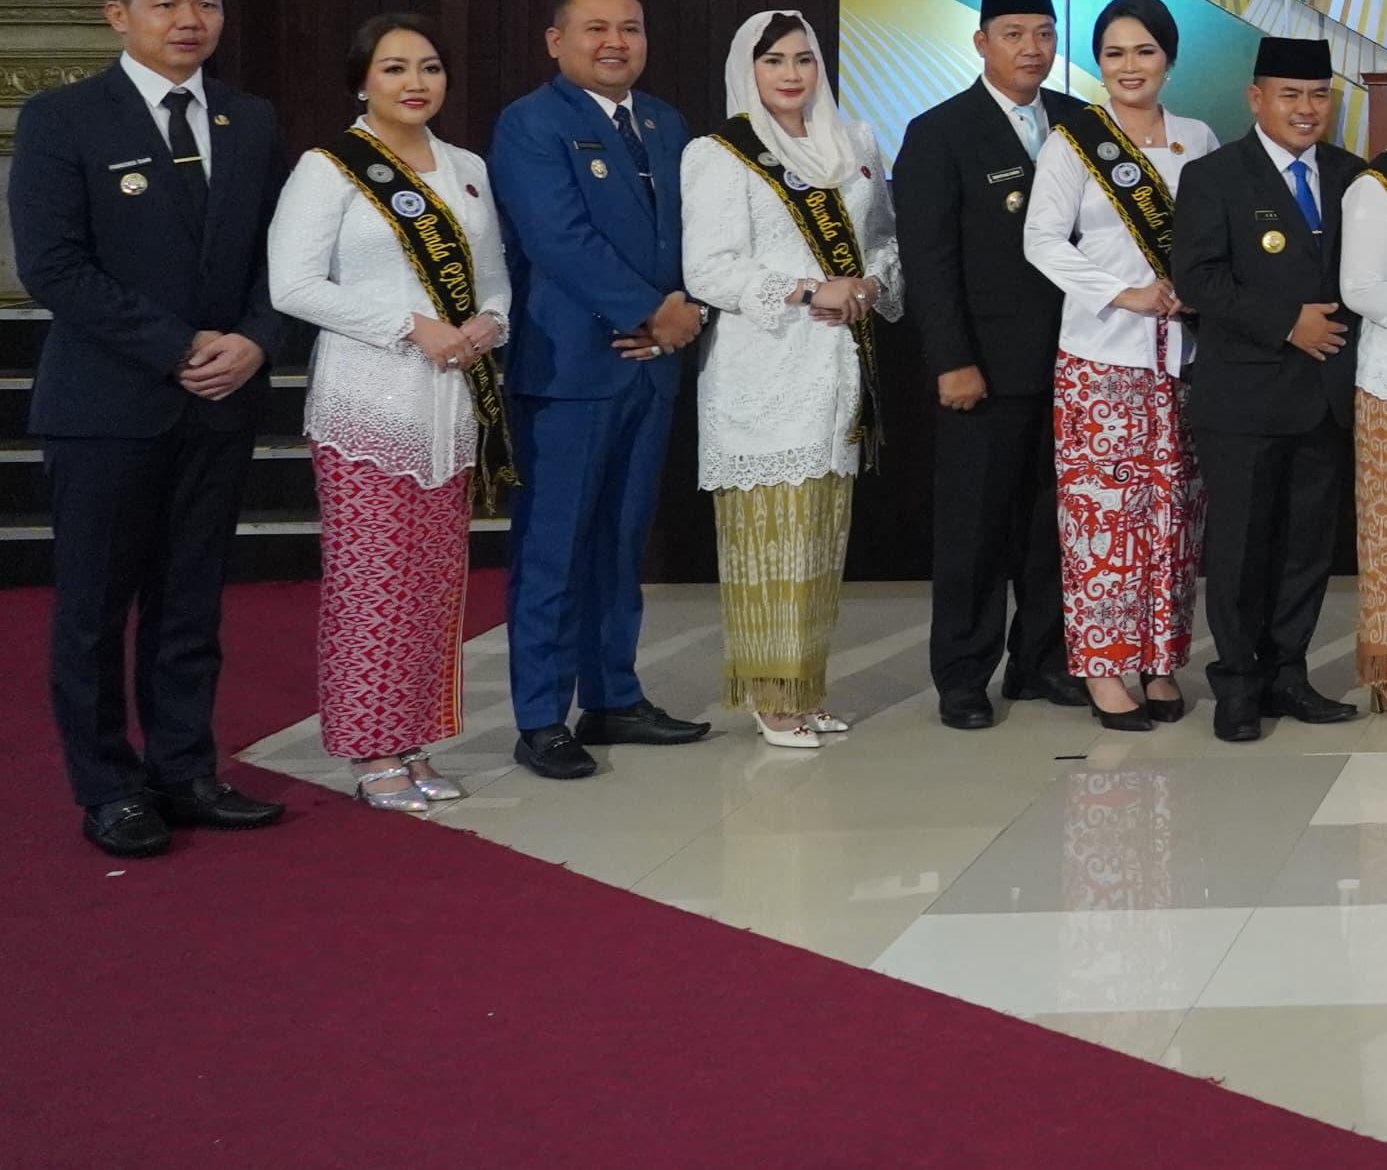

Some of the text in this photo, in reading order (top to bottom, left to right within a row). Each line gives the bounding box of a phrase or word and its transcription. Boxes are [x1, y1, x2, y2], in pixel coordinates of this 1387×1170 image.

[804, 191, 861, 279] Bunda PAU
[1130, 186, 1173, 230] Bunda
[413, 214, 472, 312] Bunda PAUD
